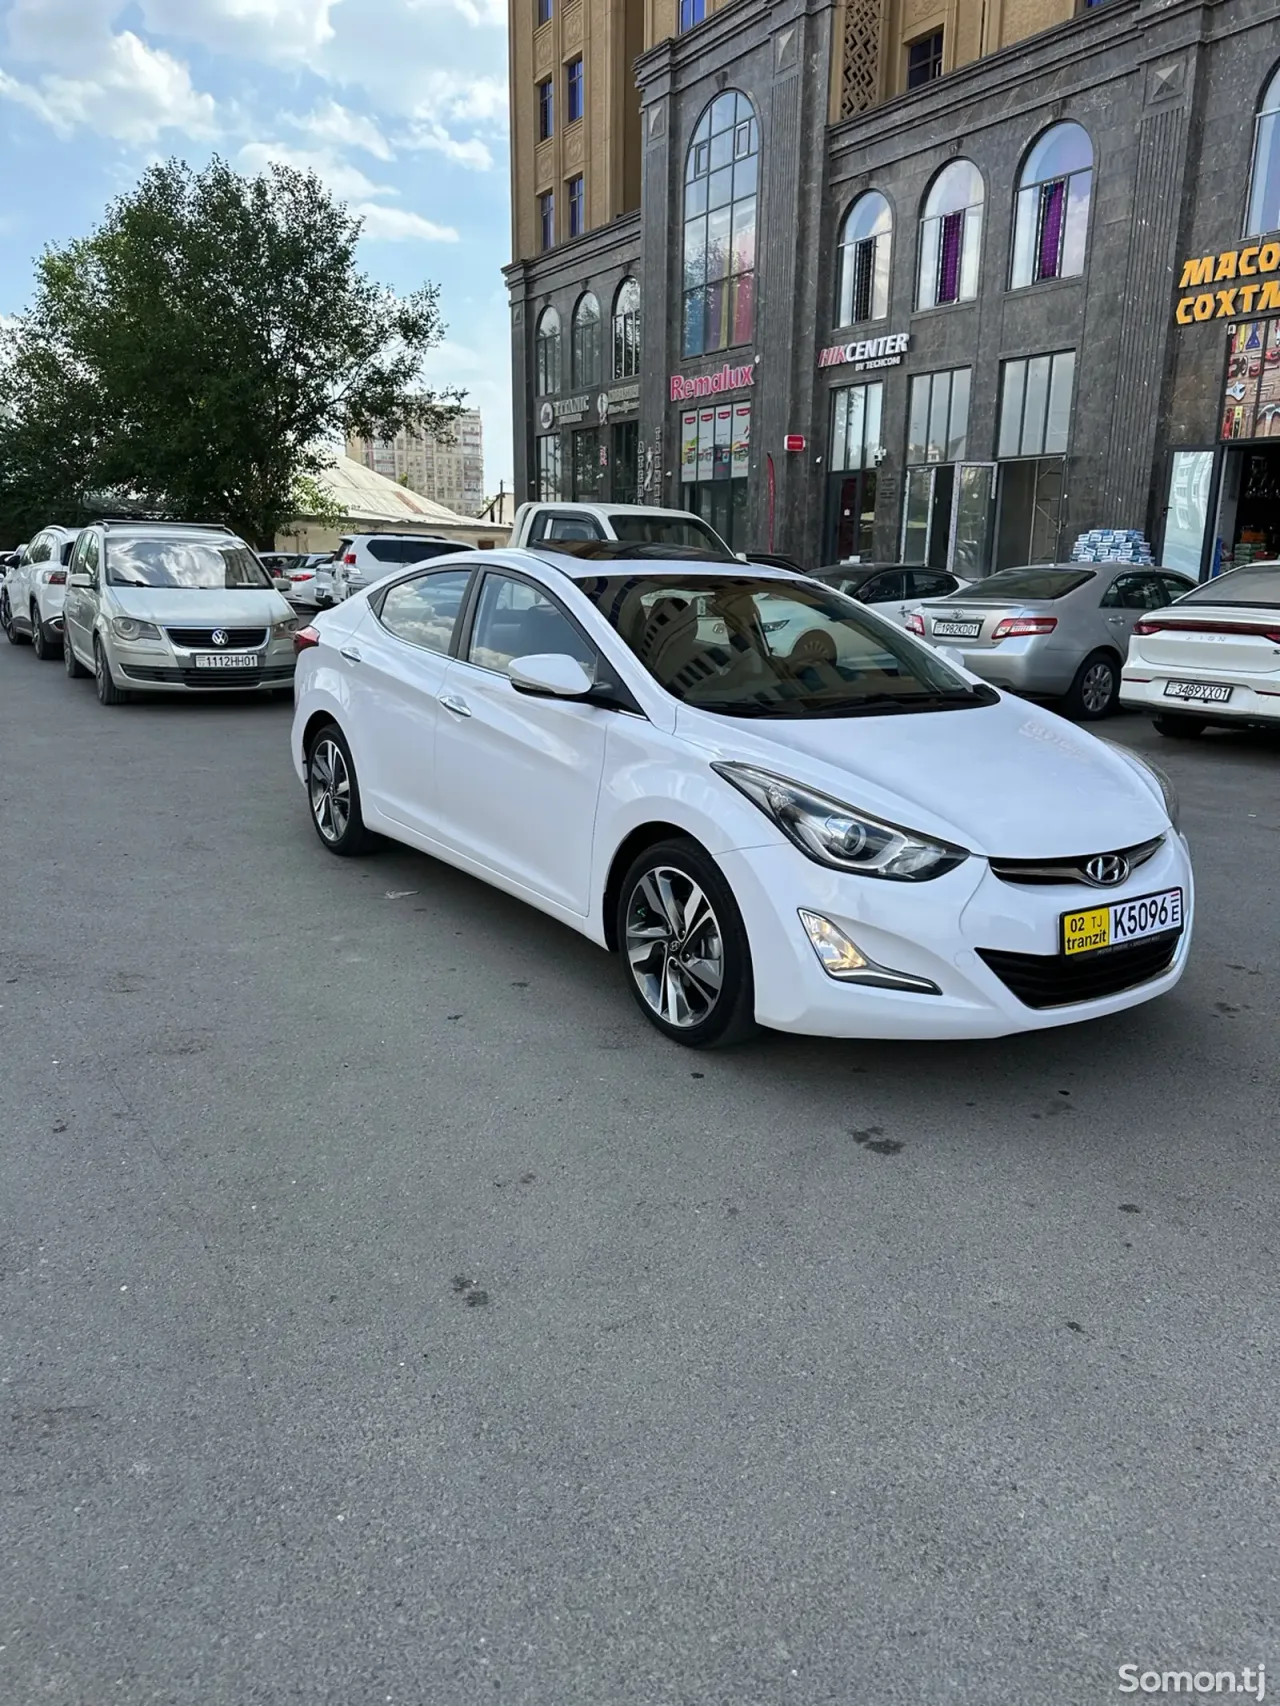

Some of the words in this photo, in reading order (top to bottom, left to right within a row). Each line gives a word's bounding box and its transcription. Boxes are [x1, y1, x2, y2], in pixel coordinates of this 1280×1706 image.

[1178, 242, 1280, 288] МАСО
[818, 333, 910, 368] HIKCENTER
[855, 363, 865, 371] BY
[670, 363, 755, 401] Remalux
[207, 656, 256, 667] 1112HH01
[1175, 684, 1228, 700] 3489XX01
[1070, 917, 1085, 933] 02
[1091, 915, 1103, 928] TJ
[1113, 897, 1168, 939] K5096
[1066, 930, 1107, 951] tranzit
